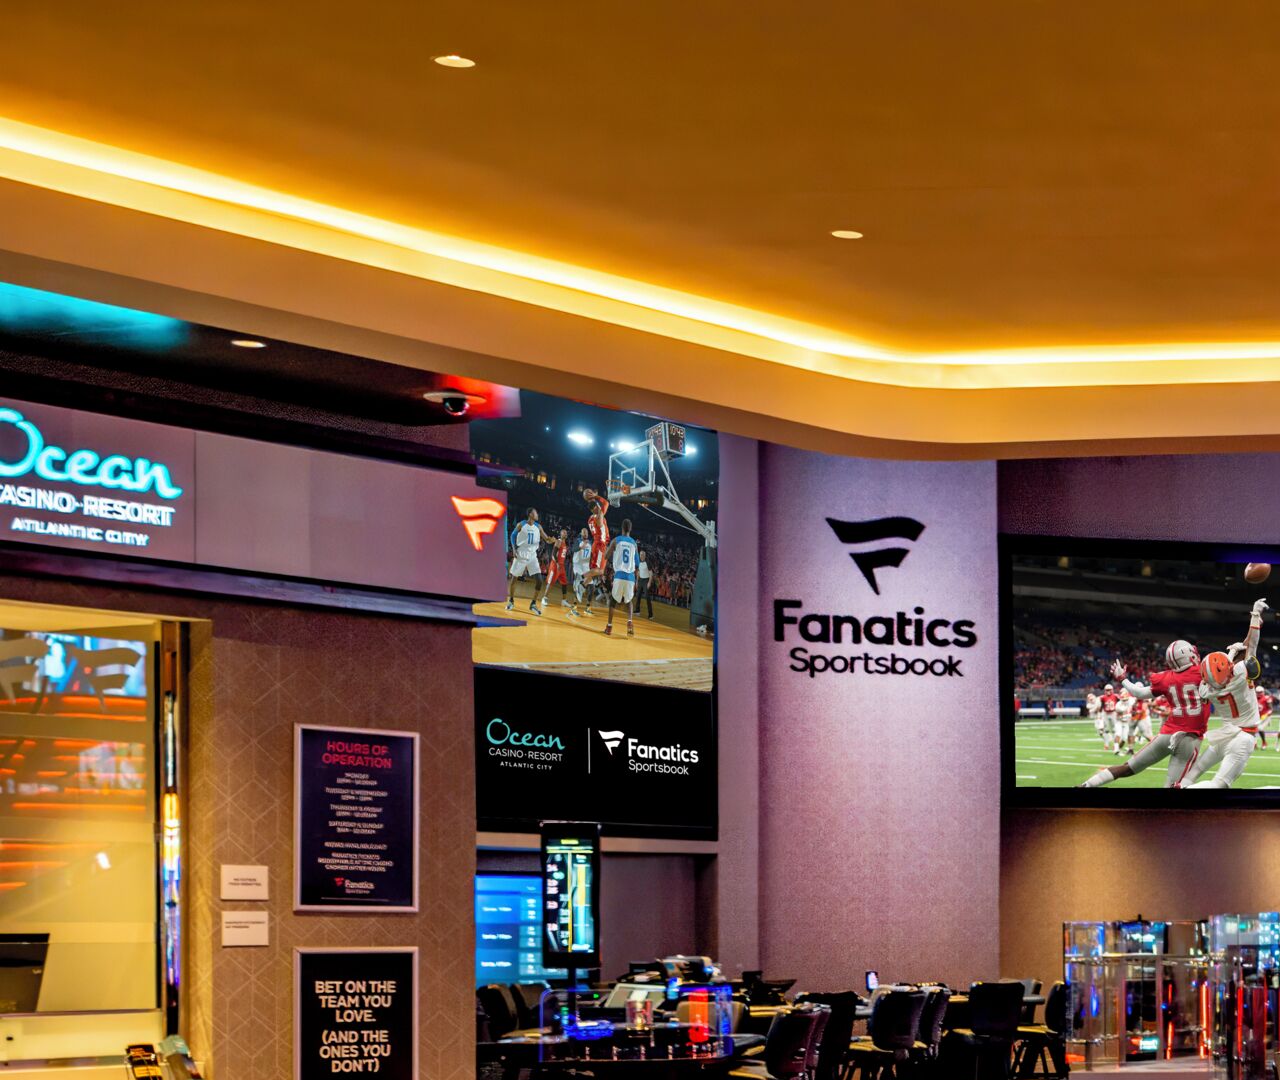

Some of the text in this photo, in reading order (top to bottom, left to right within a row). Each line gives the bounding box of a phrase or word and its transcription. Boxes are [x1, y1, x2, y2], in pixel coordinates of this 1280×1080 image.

[0, 407, 183, 499] Ocean
[0, 484, 176, 526] ASINO RESORT
[11, 517, 149, 546] ATLANTIC CITY
[773, 599, 978, 648] Fanatics
[789, 647, 964, 678] Sportsbook
[1169, 684, 1202, 716] 10
[1216, 692, 1239, 719] 7
[486, 718, 566, 750] Ocean
[326, 741, 389, 755] HOURS OF
[627, 738, 699, 763] Fanatics
[322, 752, 392, 769] OPERATION
[500, 761, 534, 769] ATLANTIC
[628, 759, 689, 776] Sportsbook
[314, 980, 396, 993] BET ON THE
[318, 995, 392, 1008] TEAM YOU
[321, 1030, 389, 1045] (AND THE
[319, 1044, 391, 1058] ONES YOU
[331, 1058, 380, 1073] DON'T)
